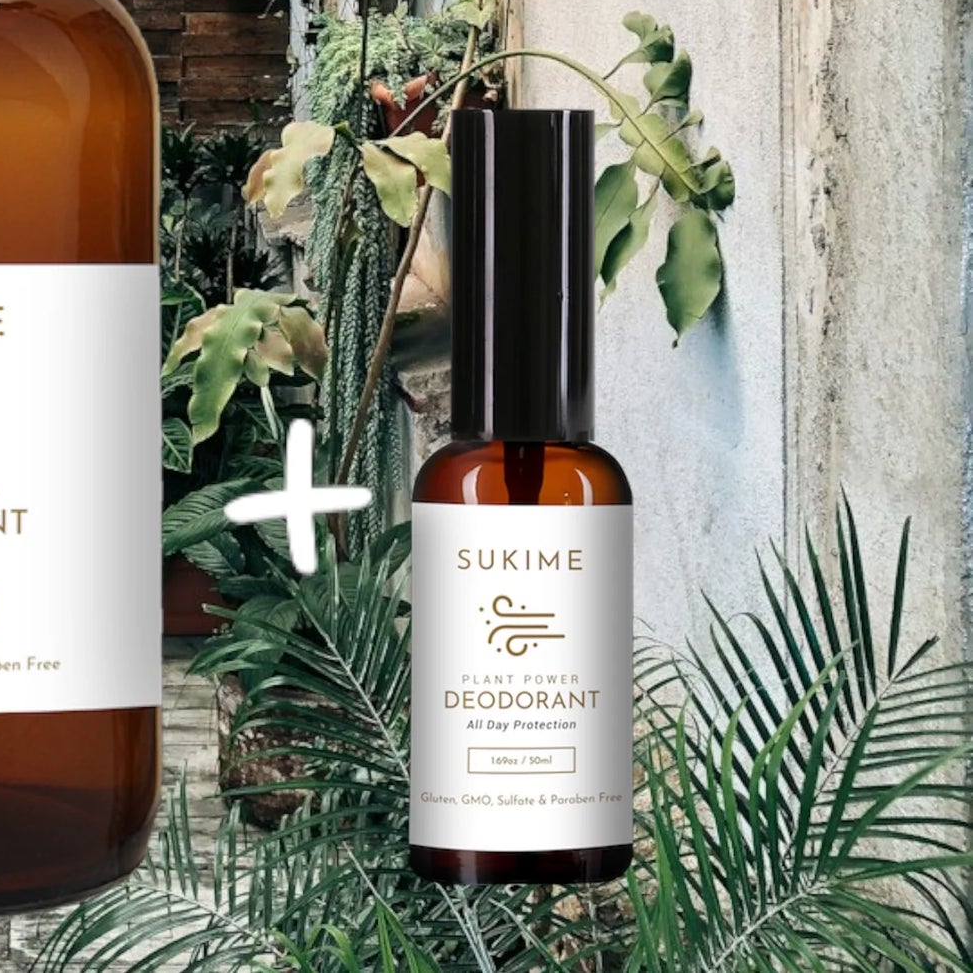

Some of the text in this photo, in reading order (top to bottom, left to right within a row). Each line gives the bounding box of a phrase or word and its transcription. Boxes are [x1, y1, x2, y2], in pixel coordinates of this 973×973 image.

[457, 548, 583, 571] SUKIME
[27, 656, 61, 670] Free
[462, 674, 578, 685] PLANT POWER
[444, 690, 601, 710] DEODORANT
[466, 719, 576, 733] All Day Protection
[420, 792, 623, 806] Gluten, GMO, Sulfate & Paraben Free
